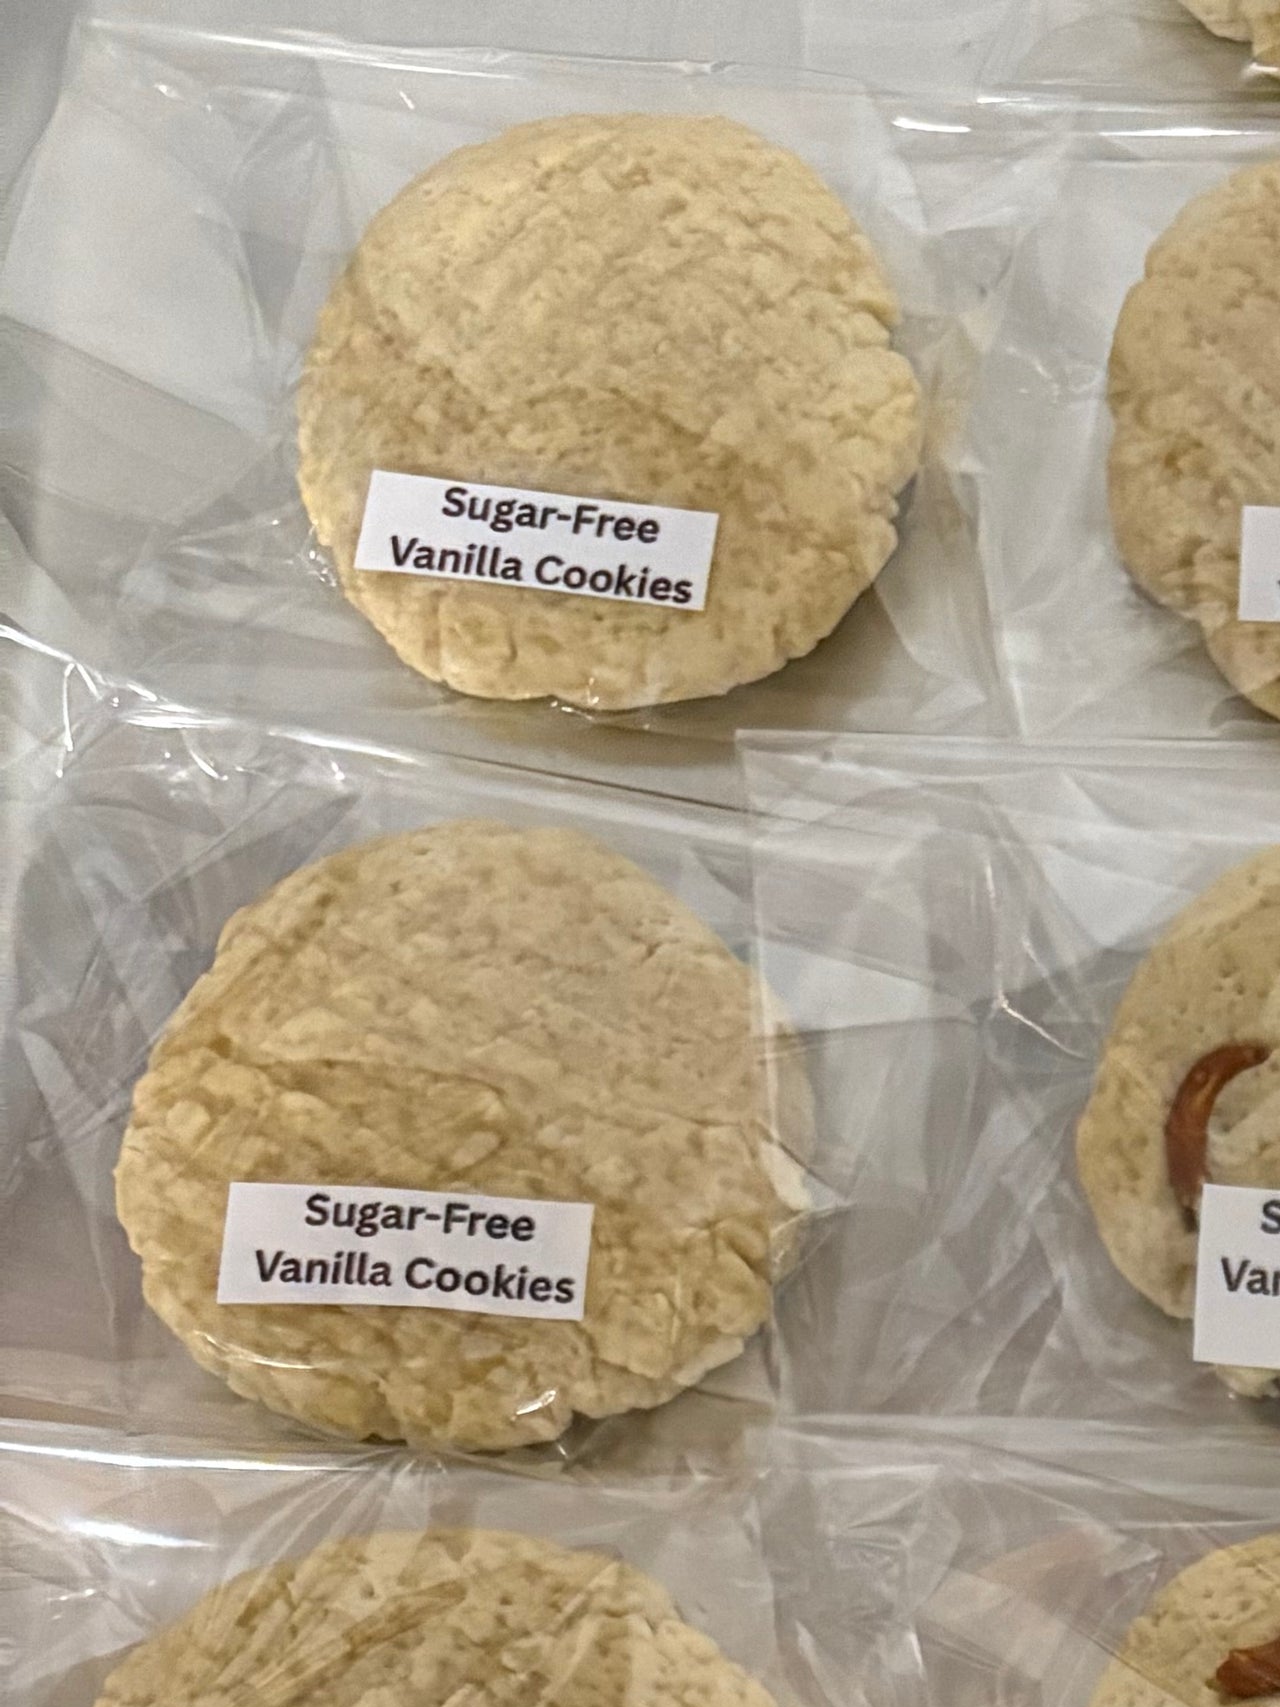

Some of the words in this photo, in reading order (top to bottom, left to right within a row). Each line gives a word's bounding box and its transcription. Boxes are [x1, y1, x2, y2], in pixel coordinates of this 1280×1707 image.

[441, 486, 661, 544] Sugar-Free
[390, 535, 523, 582] Vanilla
[534, 554, 693, 605] Cookies
[304, 1192, 536, 1242] Sugar-Free
[255, 1249, 393, 1287] Vanilla
[404, 1256, 576, 1304] Cookies
